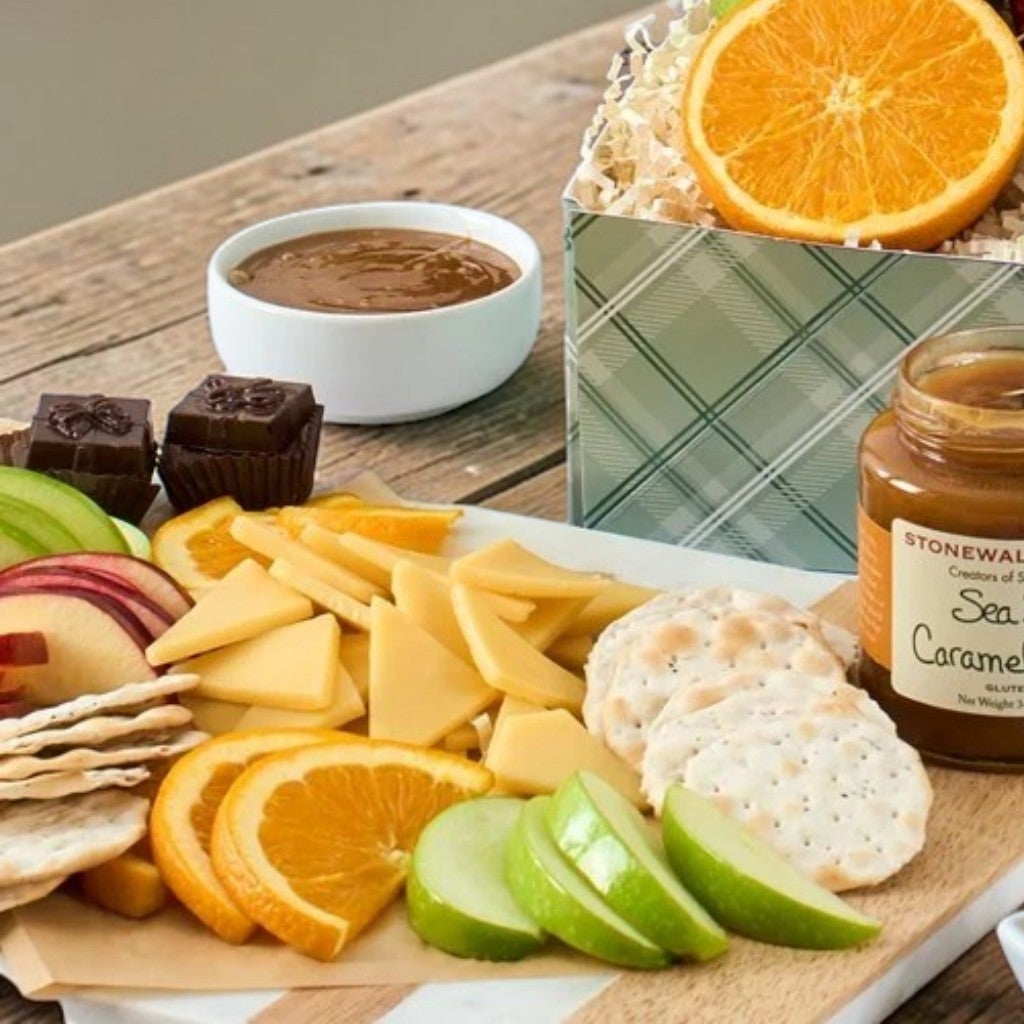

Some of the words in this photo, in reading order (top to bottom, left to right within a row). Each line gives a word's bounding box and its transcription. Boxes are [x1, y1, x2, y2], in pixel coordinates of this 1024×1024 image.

[949, 565, 998, 583] Creators
[1000, 570, 1013, 583] of
[951, 588, 1019, 625] Sea
[957, 693, 977, 706] Net
[978, 696, 1016, 711] Weight
